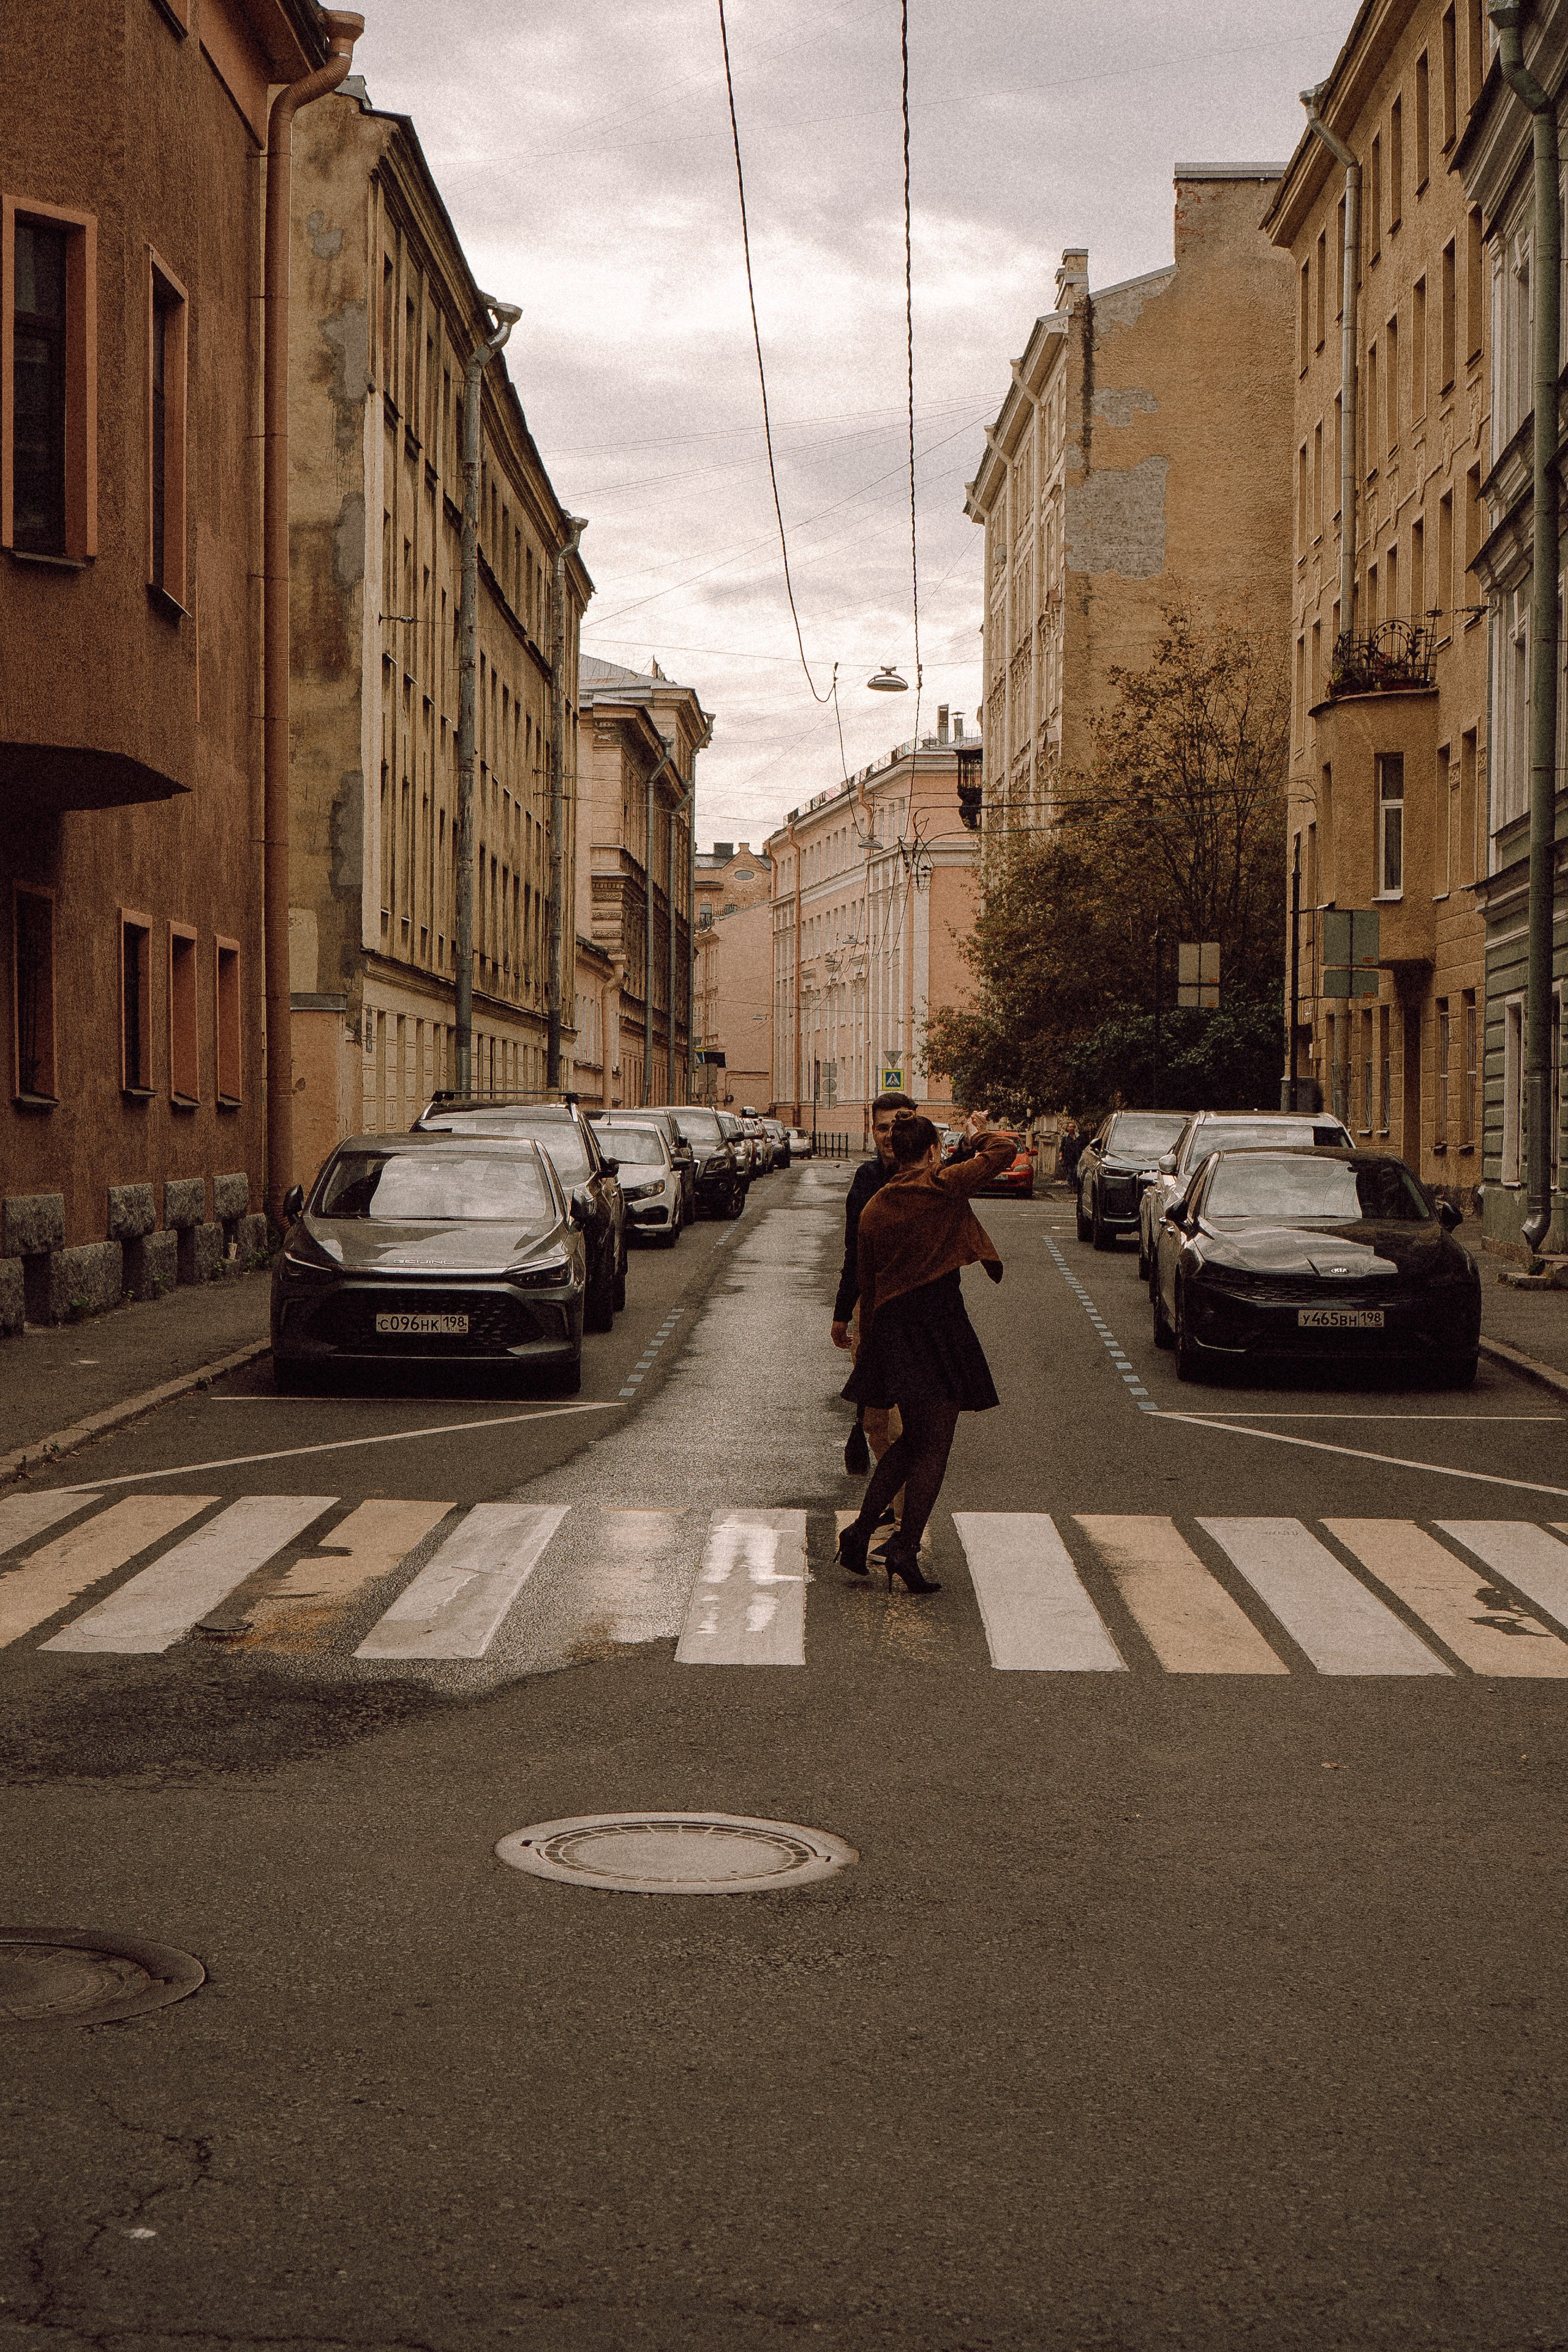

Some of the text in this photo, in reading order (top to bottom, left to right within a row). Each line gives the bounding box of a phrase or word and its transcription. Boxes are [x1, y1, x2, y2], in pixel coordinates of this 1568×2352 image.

[380, 1316, 464, 1330] С096НК 198
[1303, 1312, 1382, 1325] У465ВН 198
